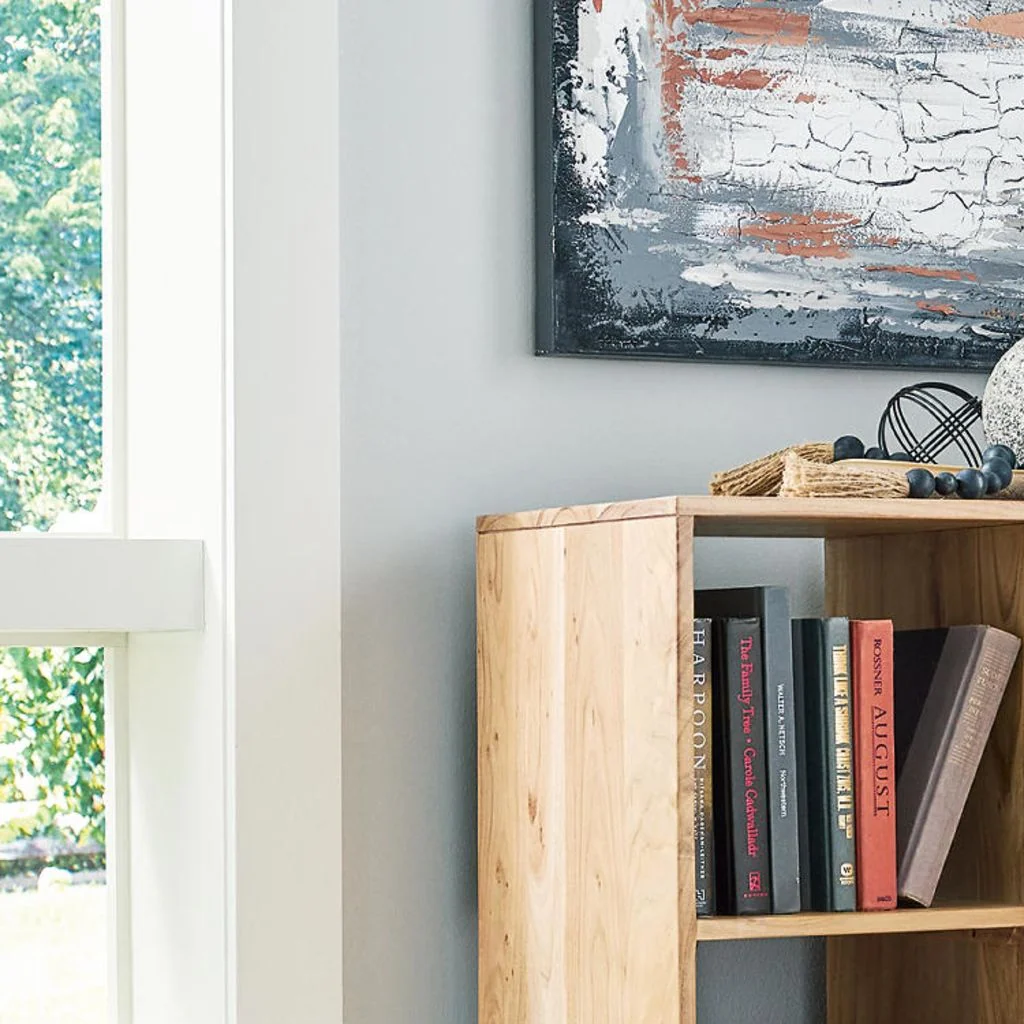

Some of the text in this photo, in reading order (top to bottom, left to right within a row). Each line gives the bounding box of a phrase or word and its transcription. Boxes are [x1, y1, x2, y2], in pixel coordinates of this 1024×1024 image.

[694, 628, 708, 770] HARPOON
[737, 636, 755, 735] The Family Tree
[777, 683, 786, 715] WALTER
[872, 638, 883, 696] ROSSNER
[778, 724, 787, 756] NETSCH
[874, 706, 890, 816] AUGUST
[744, 747, 760, 858] Carole Cadwalladr
[779, 769, 788, 818] Northwestern
